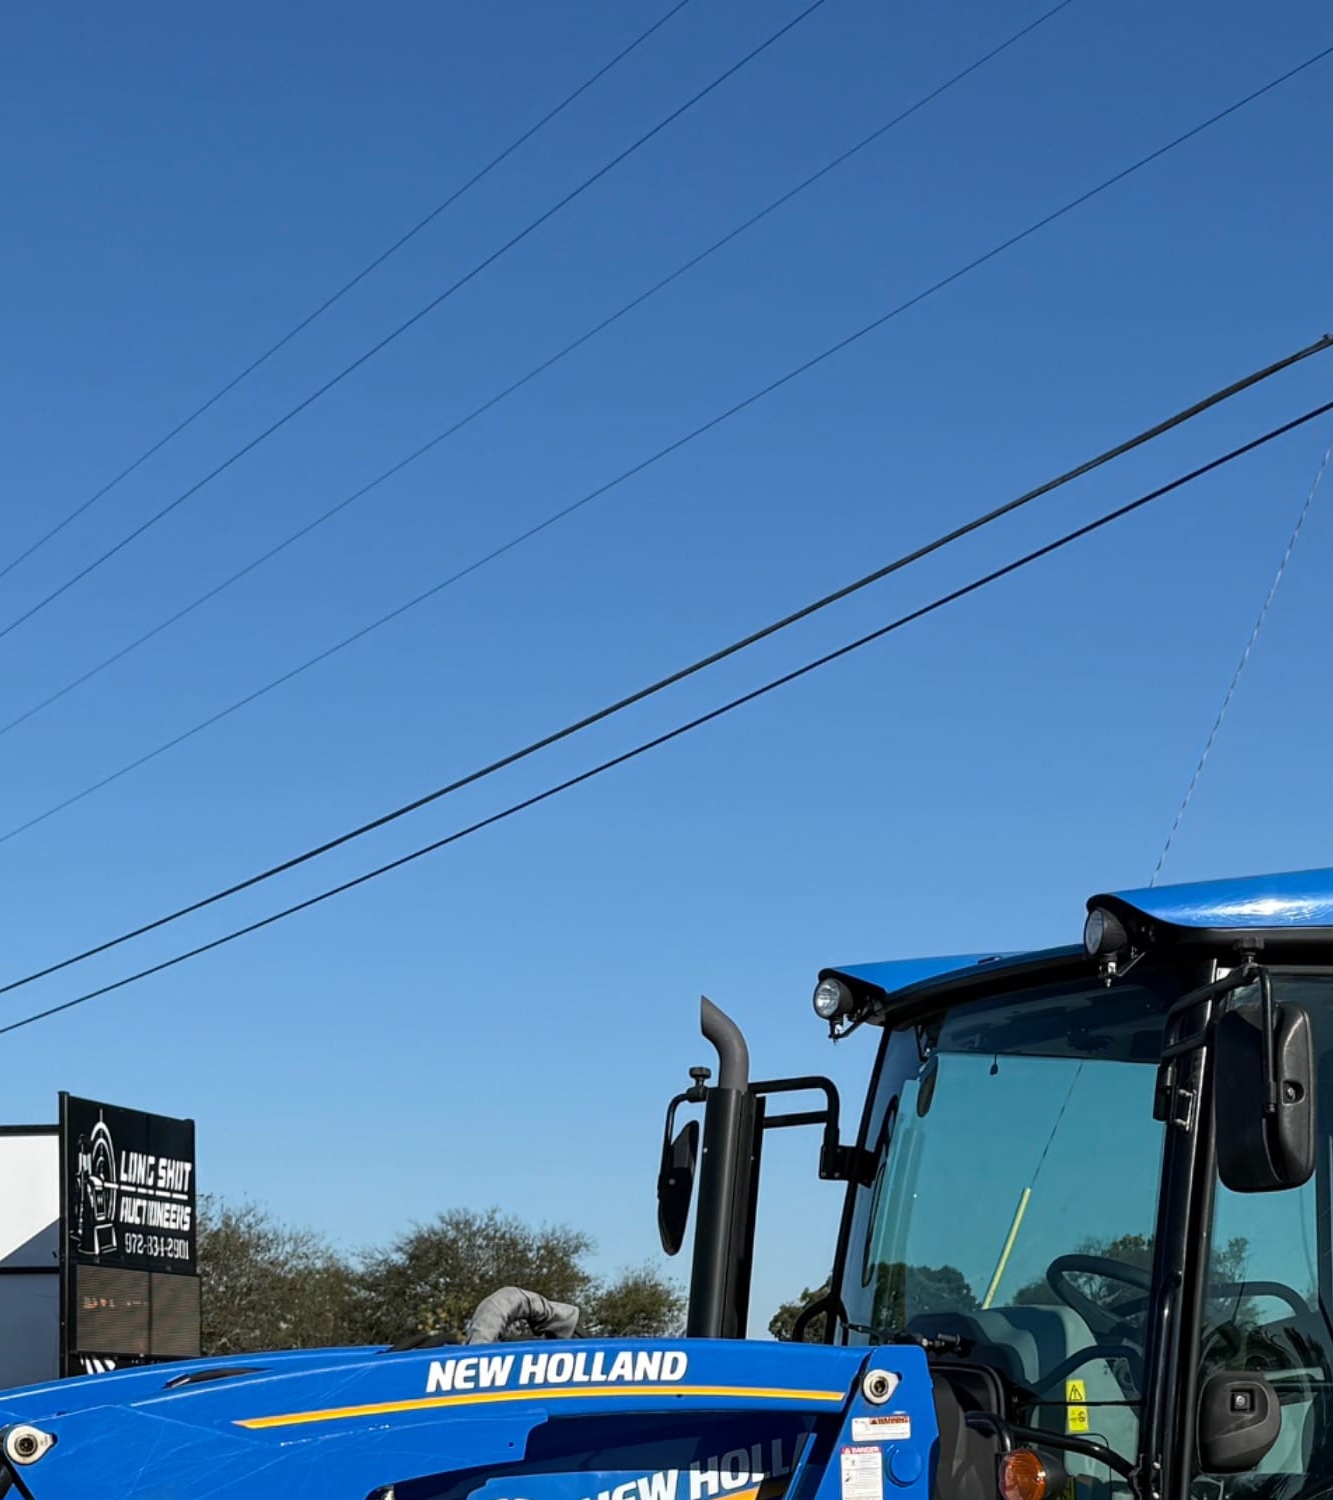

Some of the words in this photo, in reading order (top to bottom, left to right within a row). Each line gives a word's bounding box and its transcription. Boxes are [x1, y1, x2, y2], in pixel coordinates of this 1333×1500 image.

[120, 1150, 155, 1186] LONG
[157, 1157, 192, 1192] SHOT
[120, 1196, 192, 1231] AUCTIONEERS
[426, 1355, 515, 1392] NEW
[519, 1351, 688, 1385] HOLLAND
